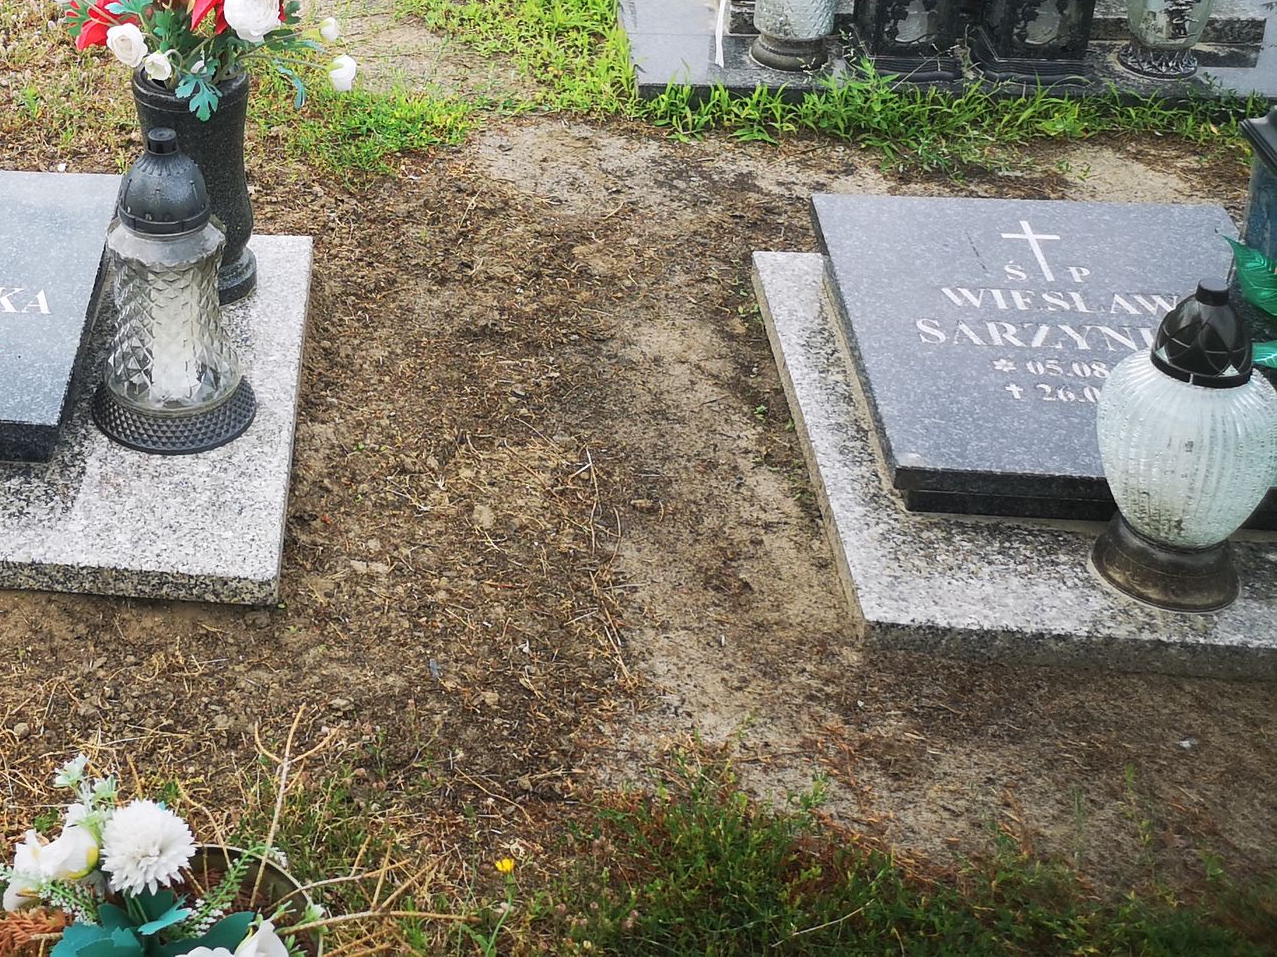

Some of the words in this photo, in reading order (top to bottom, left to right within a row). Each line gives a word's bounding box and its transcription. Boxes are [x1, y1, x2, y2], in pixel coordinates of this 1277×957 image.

[1003, 260, 1028, 281] Ś
[1067, 265, 1091, 283] P
[1025, 359, 1111, 379] 05.08
